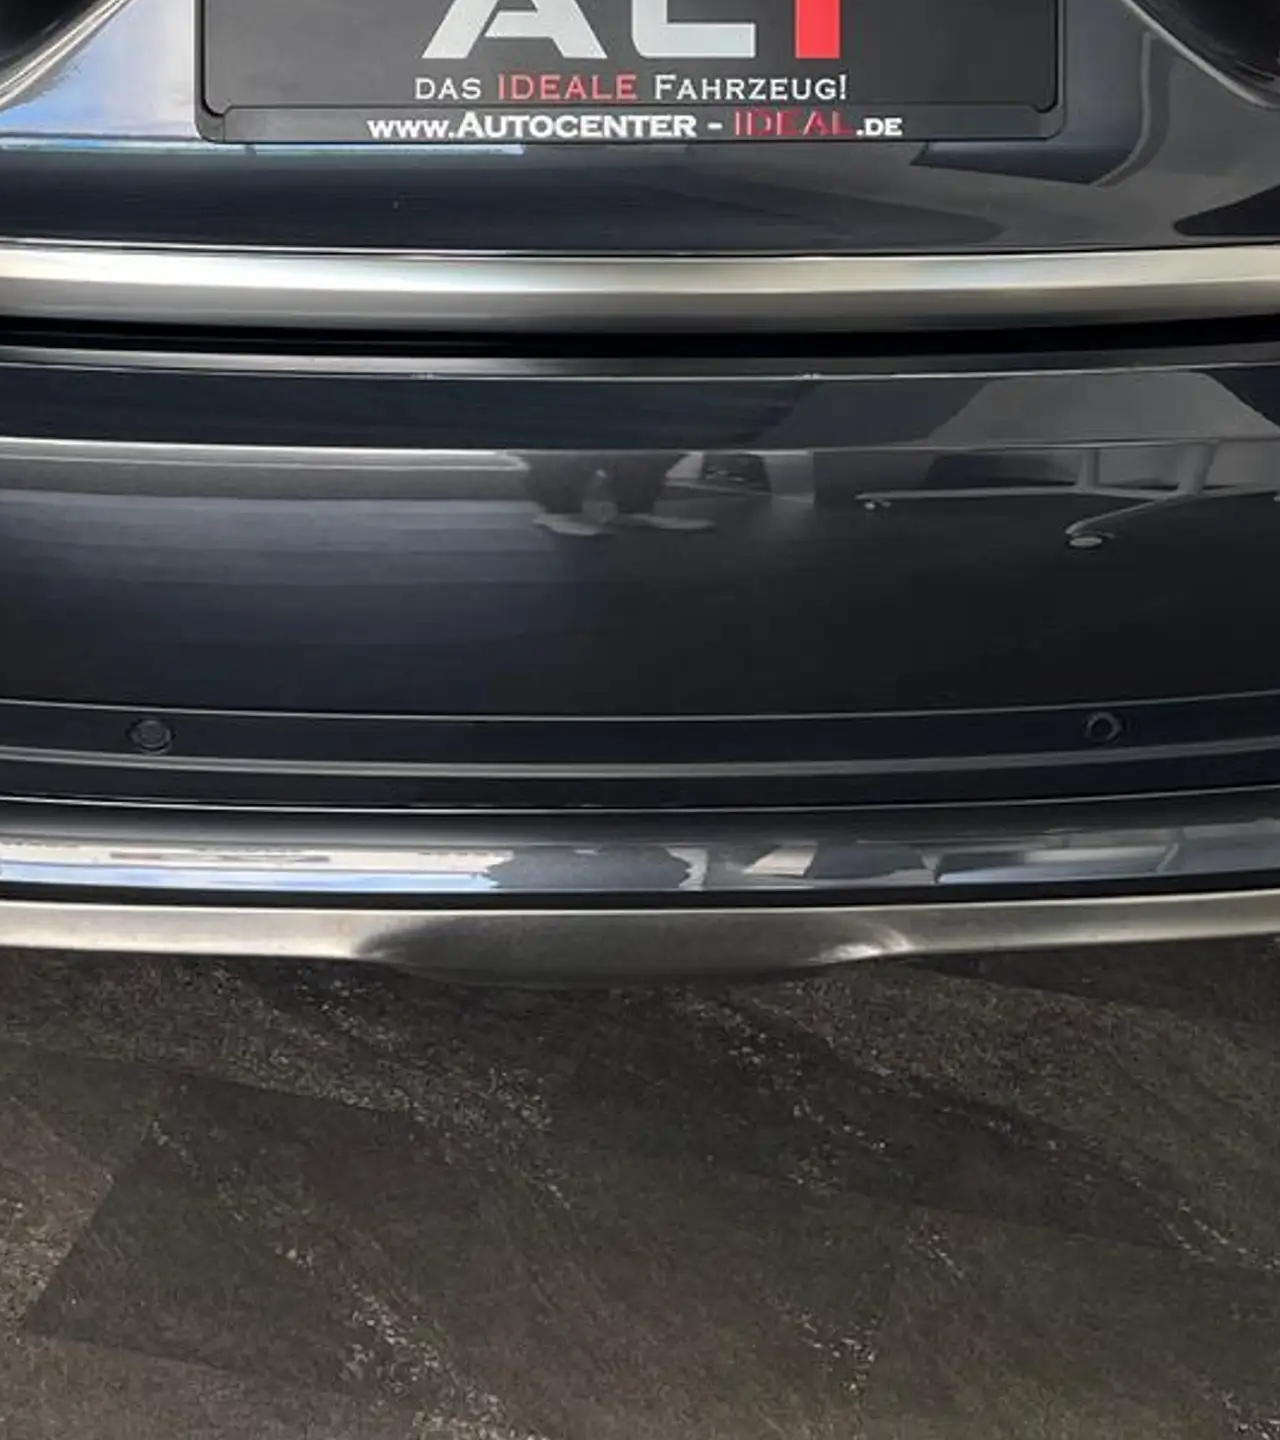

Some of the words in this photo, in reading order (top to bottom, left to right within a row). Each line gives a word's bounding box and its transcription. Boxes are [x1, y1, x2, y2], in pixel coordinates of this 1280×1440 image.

[414, 77, 482, 100] DAS
[497, 73, 638, 100] IDEALE
[654, 73, 848, 101] FAHRZEUG!
